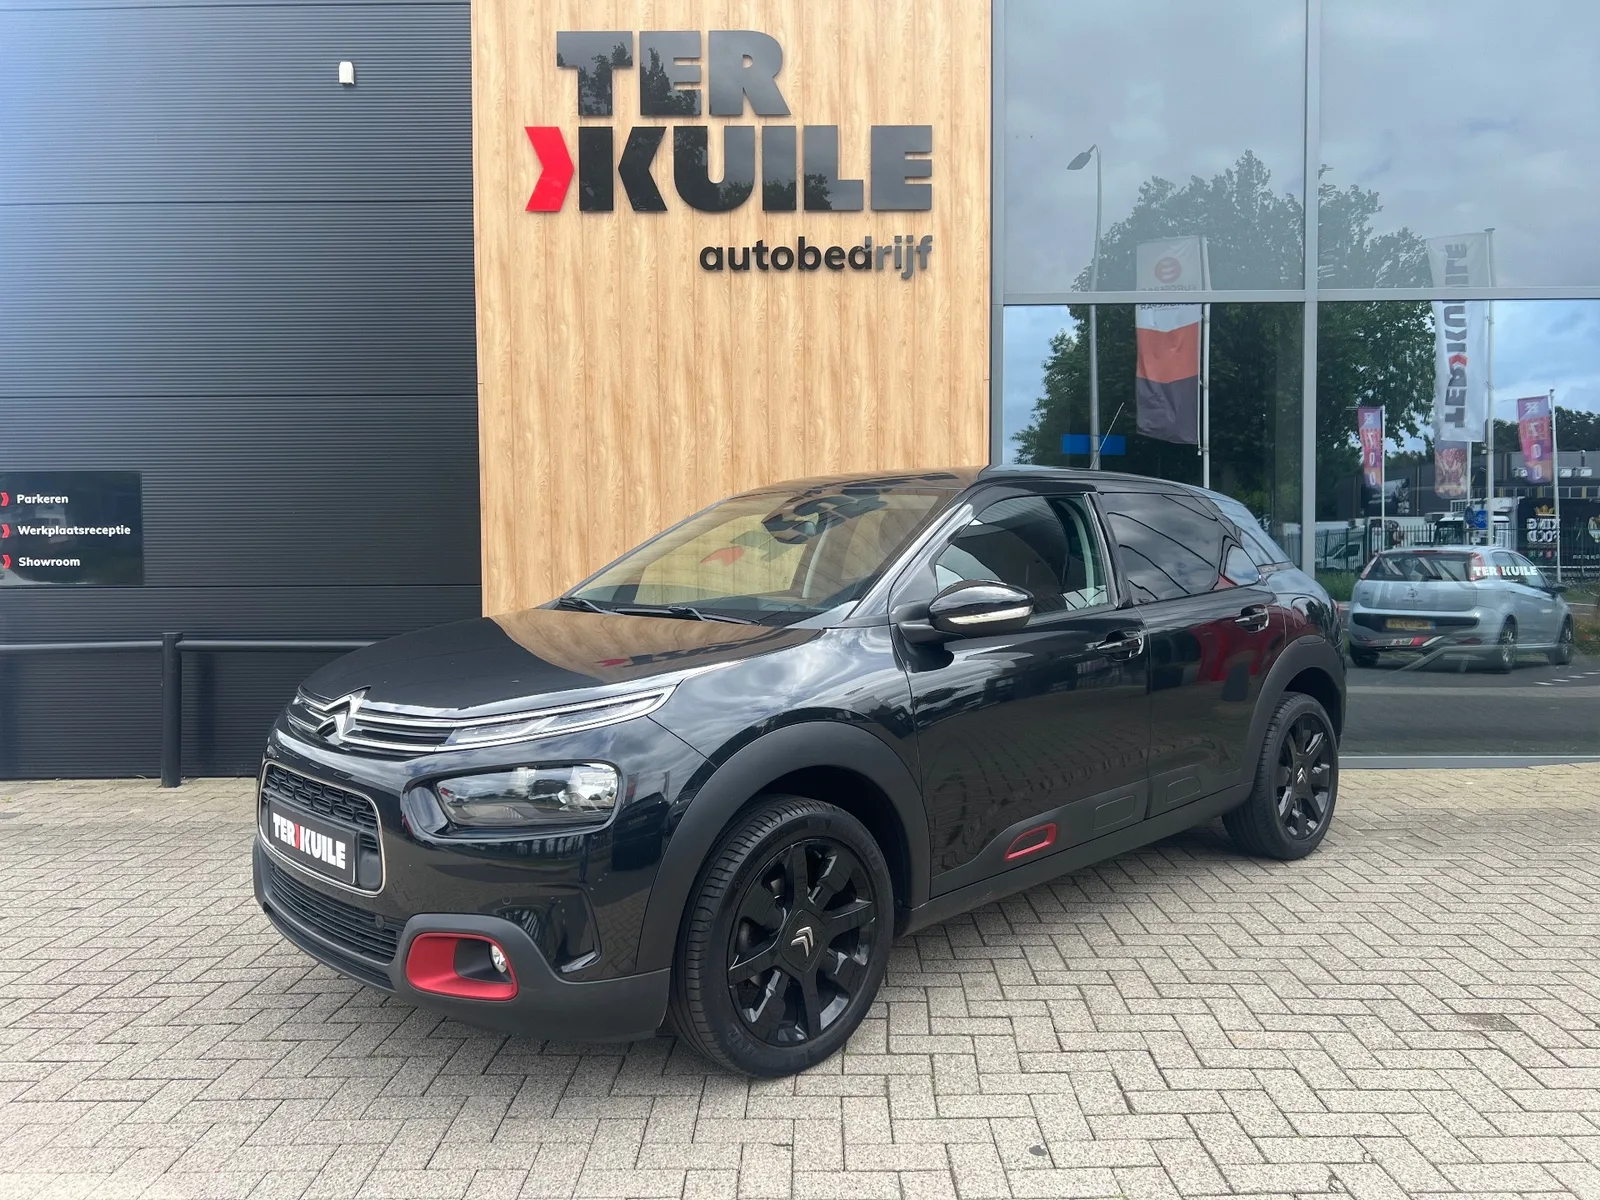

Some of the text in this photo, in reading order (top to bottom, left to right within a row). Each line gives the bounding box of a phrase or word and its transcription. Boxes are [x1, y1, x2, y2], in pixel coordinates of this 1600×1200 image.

[556, 30, 791, 116] TER
[578, 125, 933, 212] KUILE
[699, 235, 934, 280] autobedrijf
[16, 494, 69, 504] Parkeren
[17, 525, 131, 537] Werkplaatsreceptie
[18, 557, 81, 567] Showroom
[1473, 566, 1538, 576] TER KUILE
[272, 812, 346, 870] TER KUILE
